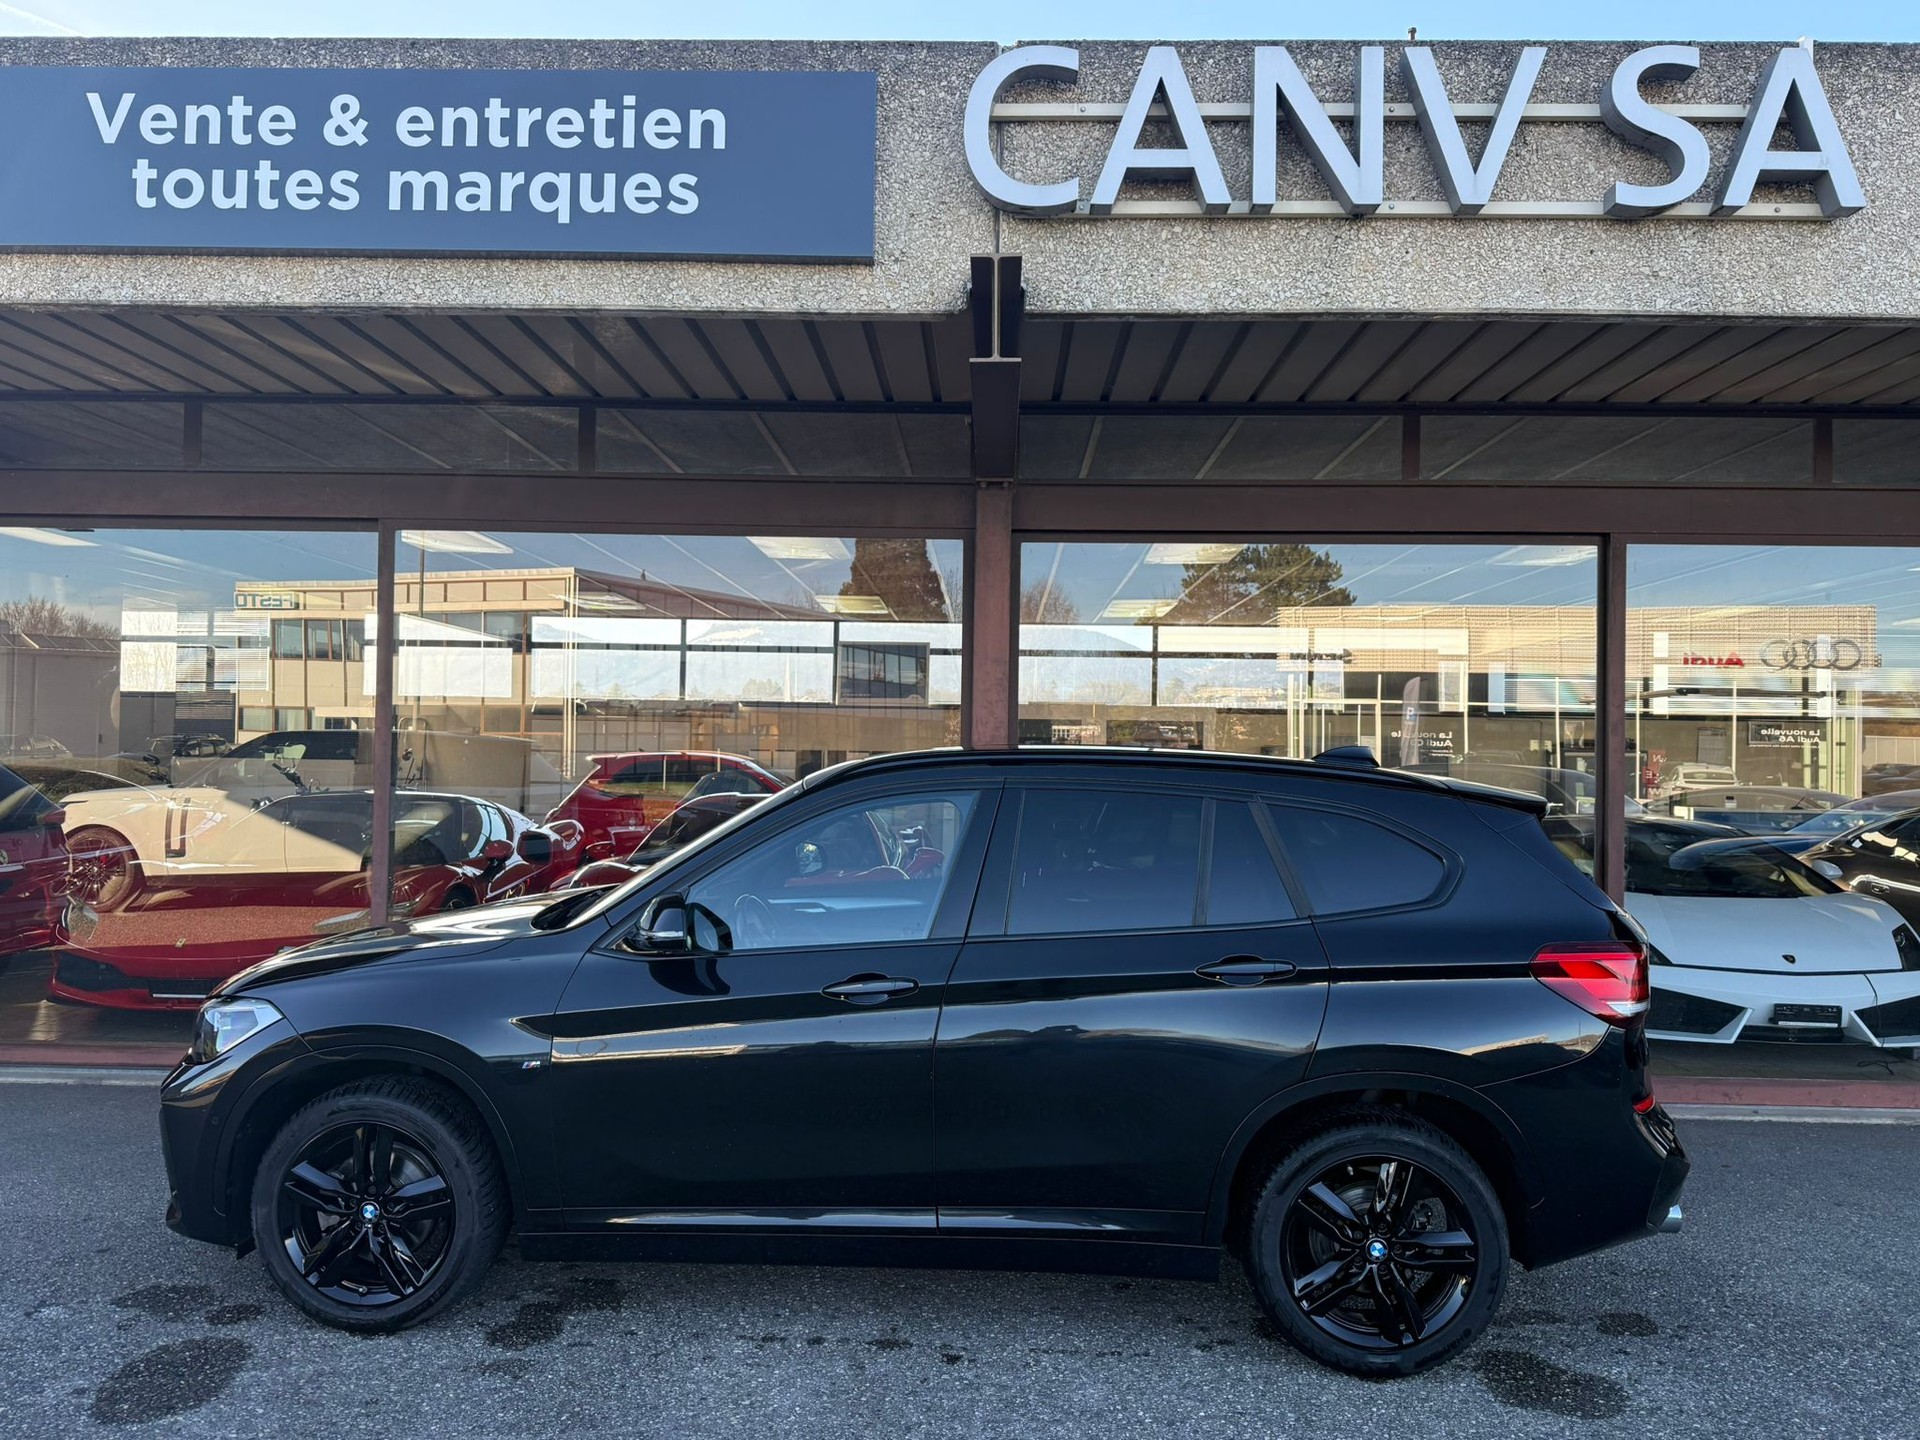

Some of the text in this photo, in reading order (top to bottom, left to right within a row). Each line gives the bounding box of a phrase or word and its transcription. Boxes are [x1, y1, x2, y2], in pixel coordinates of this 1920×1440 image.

[86, 93, 725, 149] Vente & entretien
[963, 44, 1866, 214] CANV SA
[132, 159, 698, 223] toutes marques
